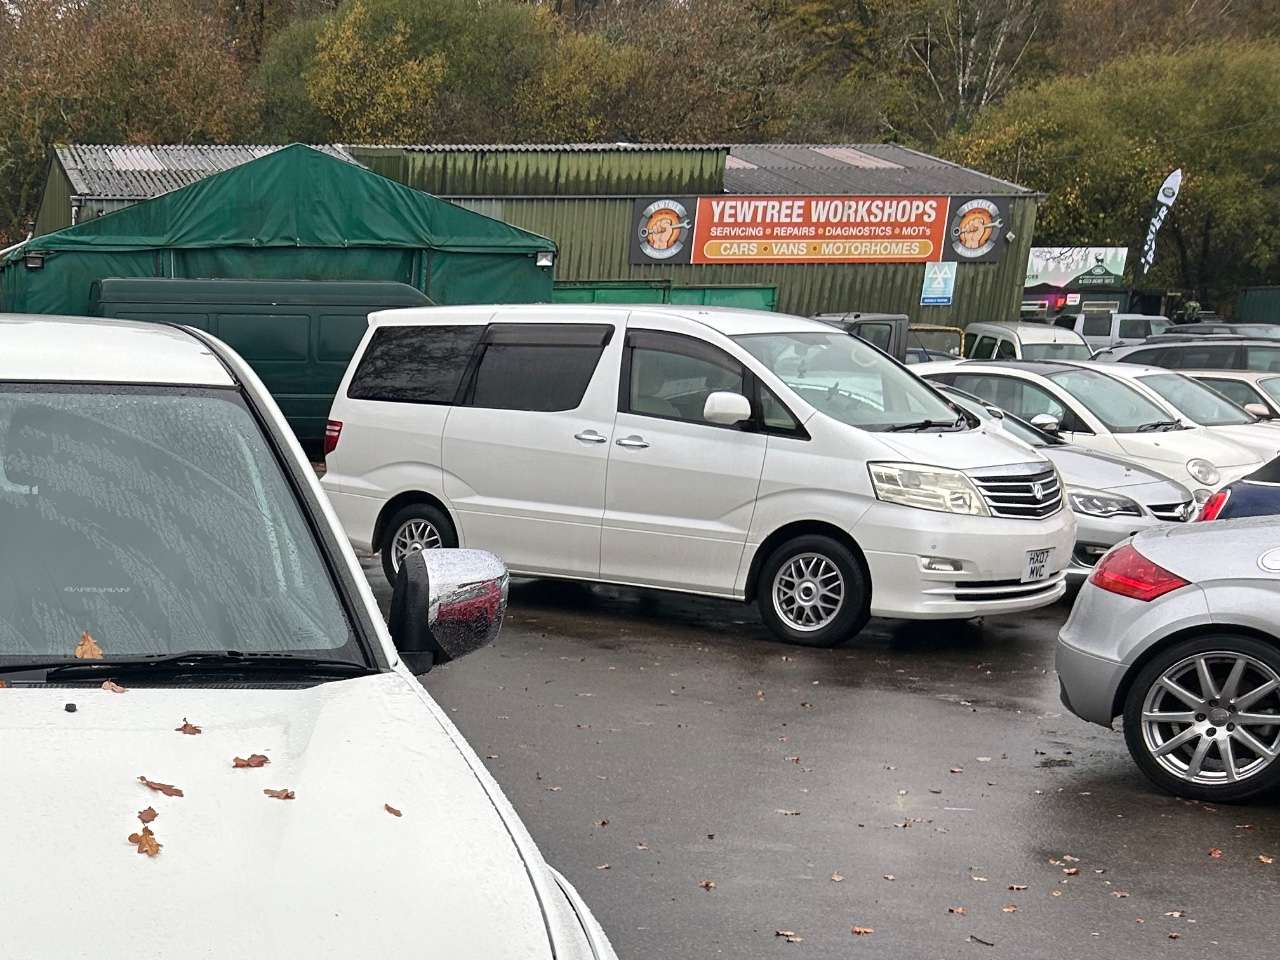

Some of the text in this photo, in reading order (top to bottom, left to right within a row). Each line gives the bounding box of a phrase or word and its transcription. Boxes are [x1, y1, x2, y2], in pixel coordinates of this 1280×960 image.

[711, 200, 937, 223] YEWTREE WORKSHOPS
[710, 227, 931, 236] SERVICING REPAIRS DIAGNOSTICS MOT's
[720, 243, 920, 255] CARS VANS MOTORHOMES
[1029, 550, 1049, 565] HX07
[1029, 565, 1045, 578] MVC
